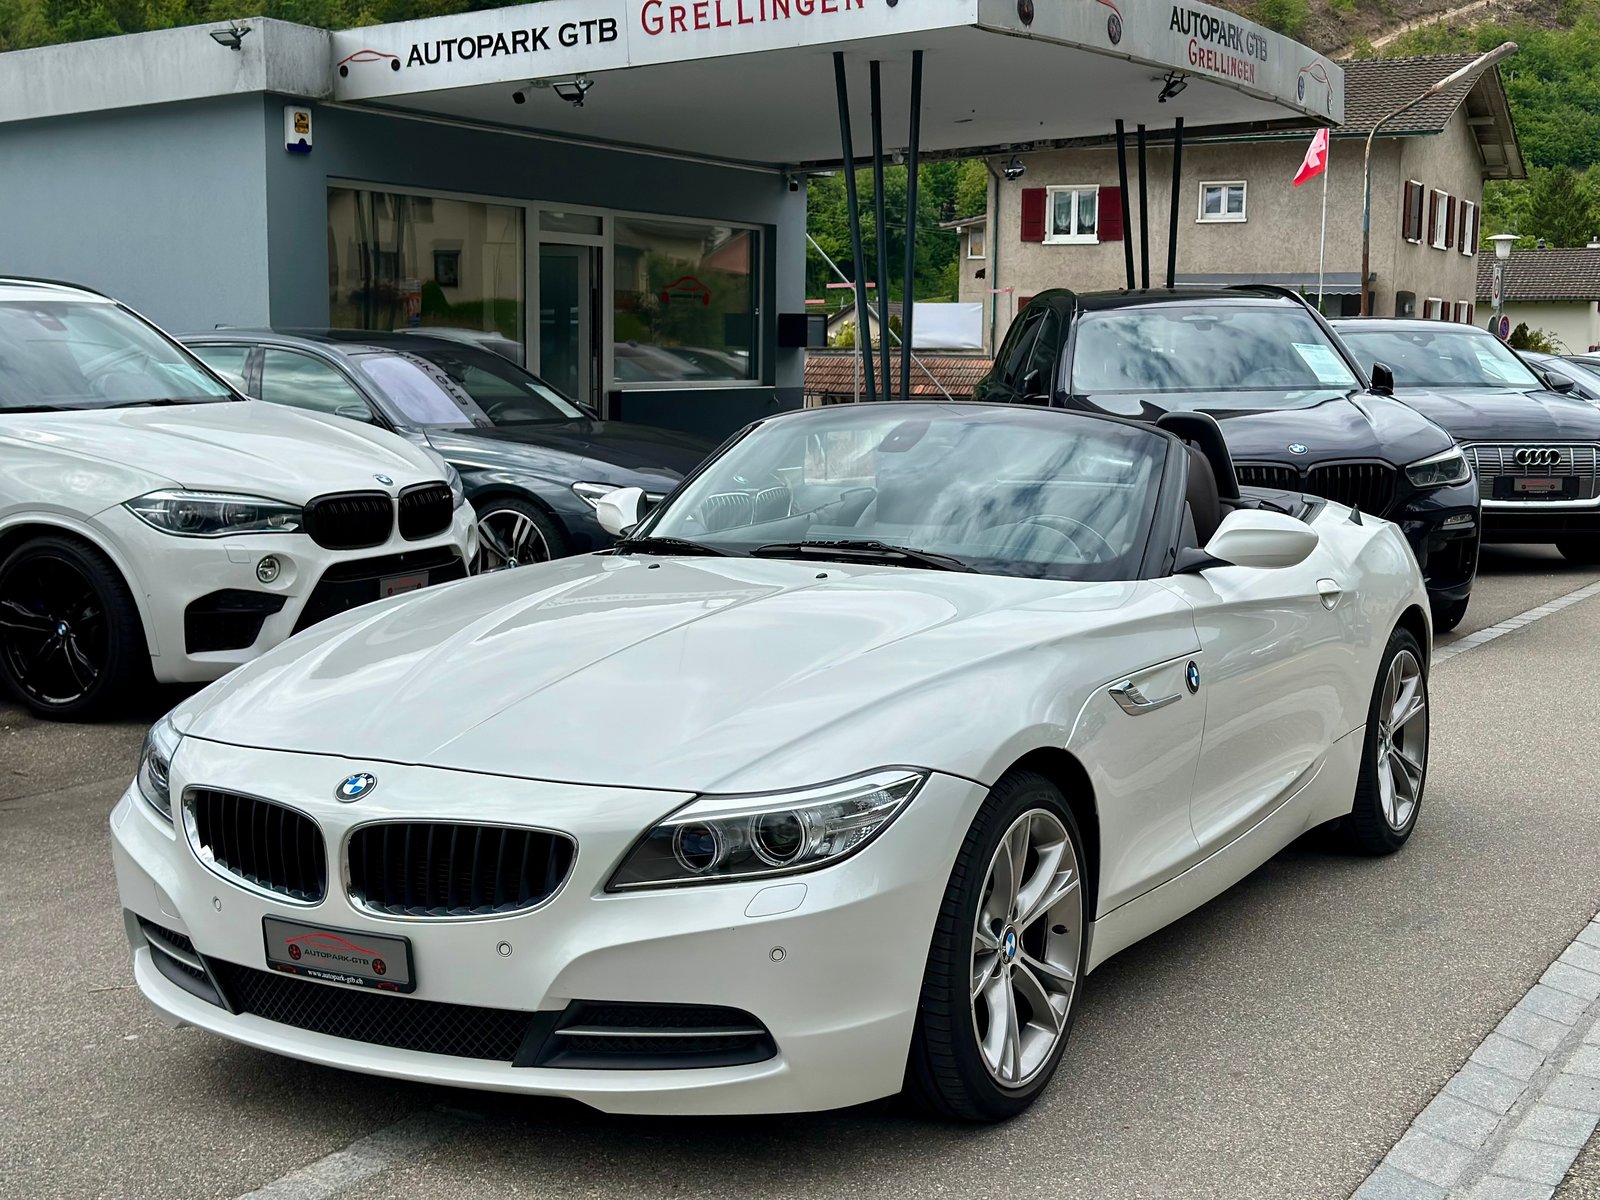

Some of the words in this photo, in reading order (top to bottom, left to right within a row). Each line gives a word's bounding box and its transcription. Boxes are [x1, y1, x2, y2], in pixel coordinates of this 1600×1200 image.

[406, 26, 551, 67] AUTOPARK
[558, 17, 618, 47] GTB
[1169, 6, 1244, 53] AUTOPARK
[1246, 31, 1268, 62] GTB
[1188, 38, 1255, 84] GRELLINGEN
[304, 948, 370, 966] AUTOPARK-GTB
[307, 969, 364, 985] www.autopark-gtb.ch
